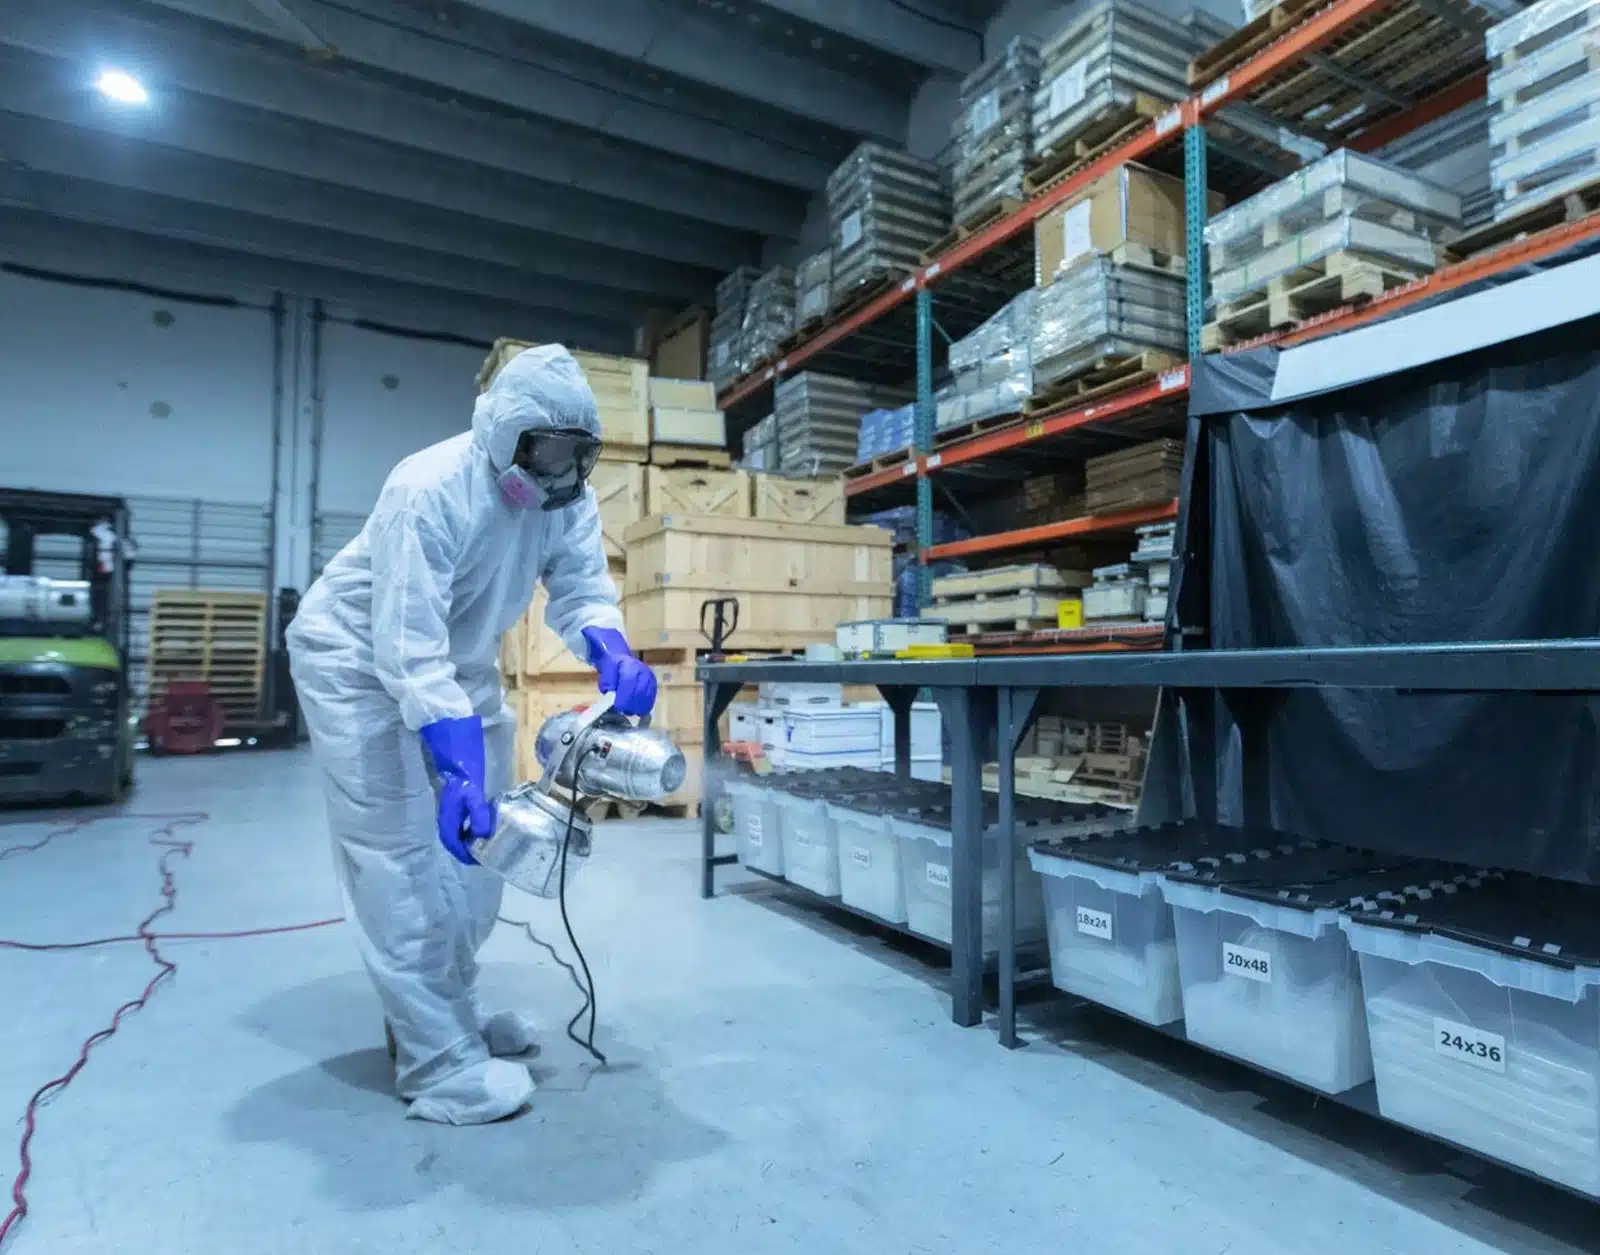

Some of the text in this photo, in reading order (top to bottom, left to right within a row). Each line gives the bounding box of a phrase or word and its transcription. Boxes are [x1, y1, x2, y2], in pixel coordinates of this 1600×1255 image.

[1078, 913, 1107, 929] 18x24
[1228, 952, 1268, 973] 20x48
[1441, 1031, 1502, 1062] 24x36
